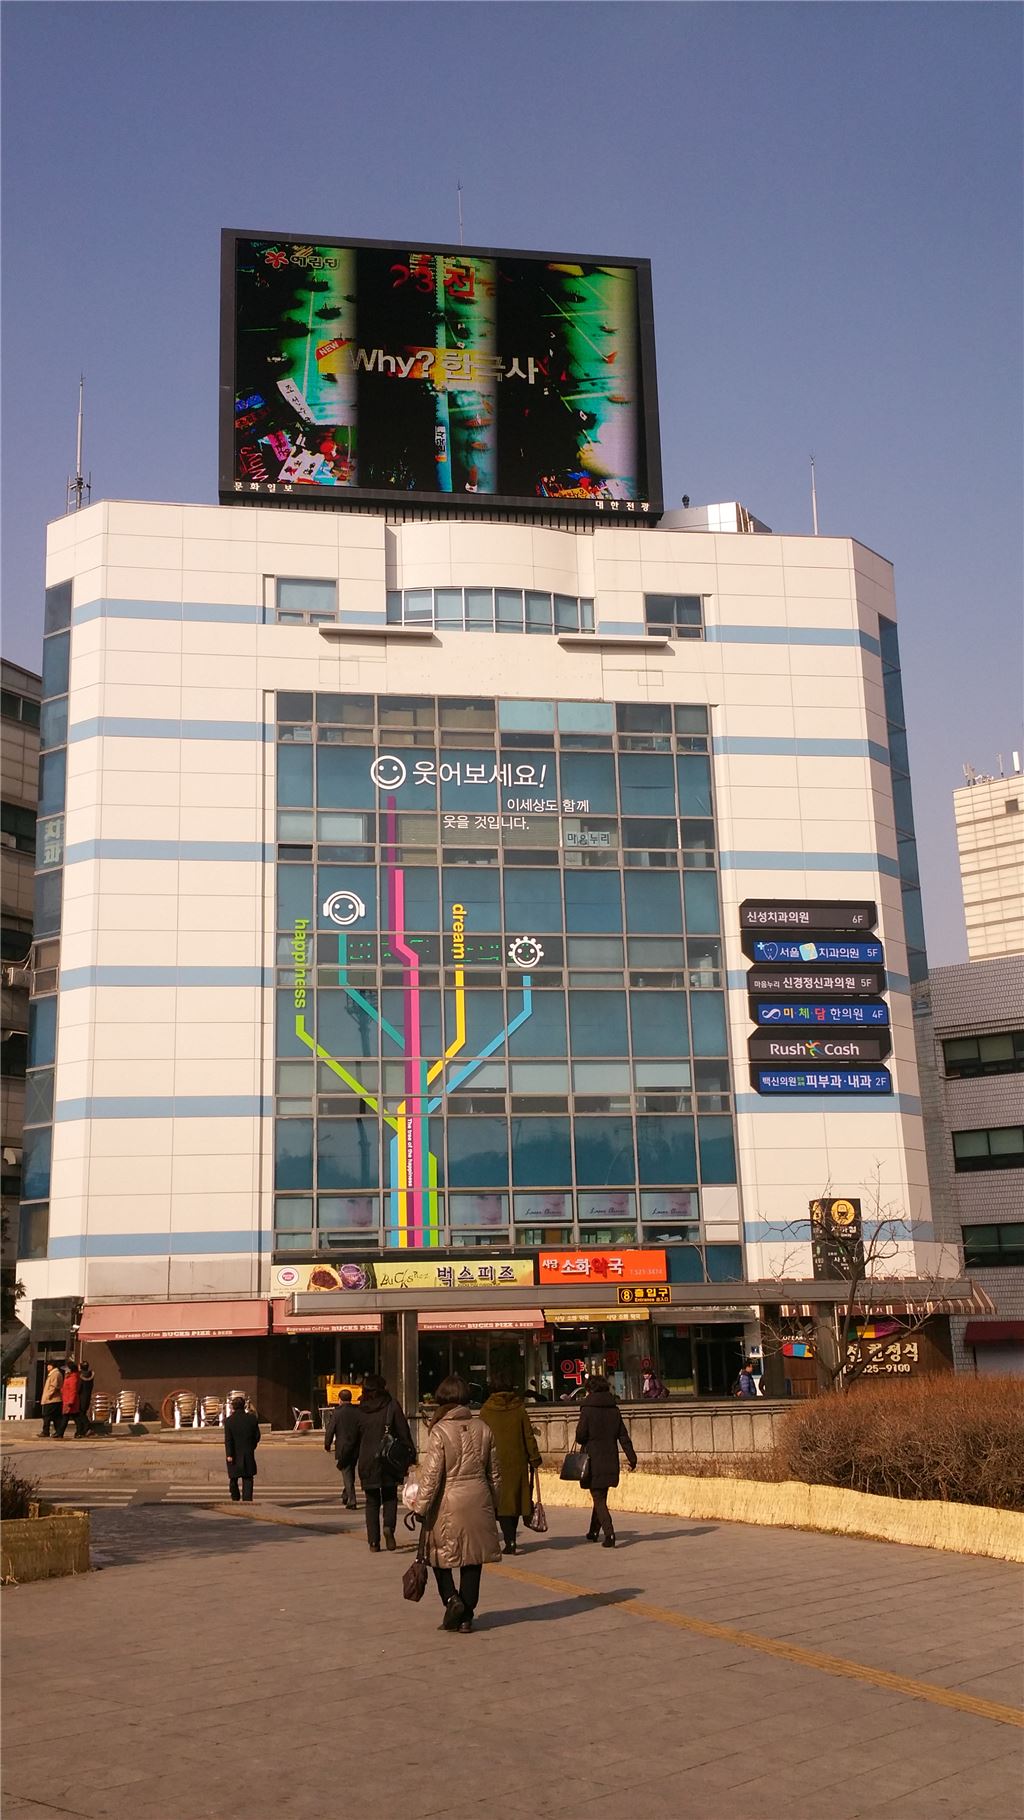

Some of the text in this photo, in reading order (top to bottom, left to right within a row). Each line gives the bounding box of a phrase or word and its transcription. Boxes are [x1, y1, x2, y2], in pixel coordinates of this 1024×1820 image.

[318, 340, 339, 357] NEW
[350, 348, 539, 385] Why? 한국사
[234, 481, 293, 493] 문화일보
[412, 761, 547, 788] 웃어보세요!
[507, 798, 589, 813] 이세상도 함께
[443, 815, 530, 830] 웃을 것입니다.
[567, 832, 610, 846] 마음누리
[747, 911, 863, 924] 신성치과의원 6F
[452, 904, 466, 959] dream
[780, 947, 878, 959] 서울 치과의원 5F
[291, 919, 310, 1008] happiness
[783, 977, 855, 989] 신경정신과의원
[861, 979, 871, 987] 5F
[830, 1008, 863, 1021] 한의원
[872, 1010, 883, 1018] 4F
[770, 1043, 860, 1055] Rush Cash
[762, 1076, 797, 1087] 백신의원
[875, 1077, 886, 1086] 2F
[437, 1265, 515, 1287] 벅스피즈
[635, 1288, 668, 1298] 출입구
[561, 1359, 585, 1385] 약
